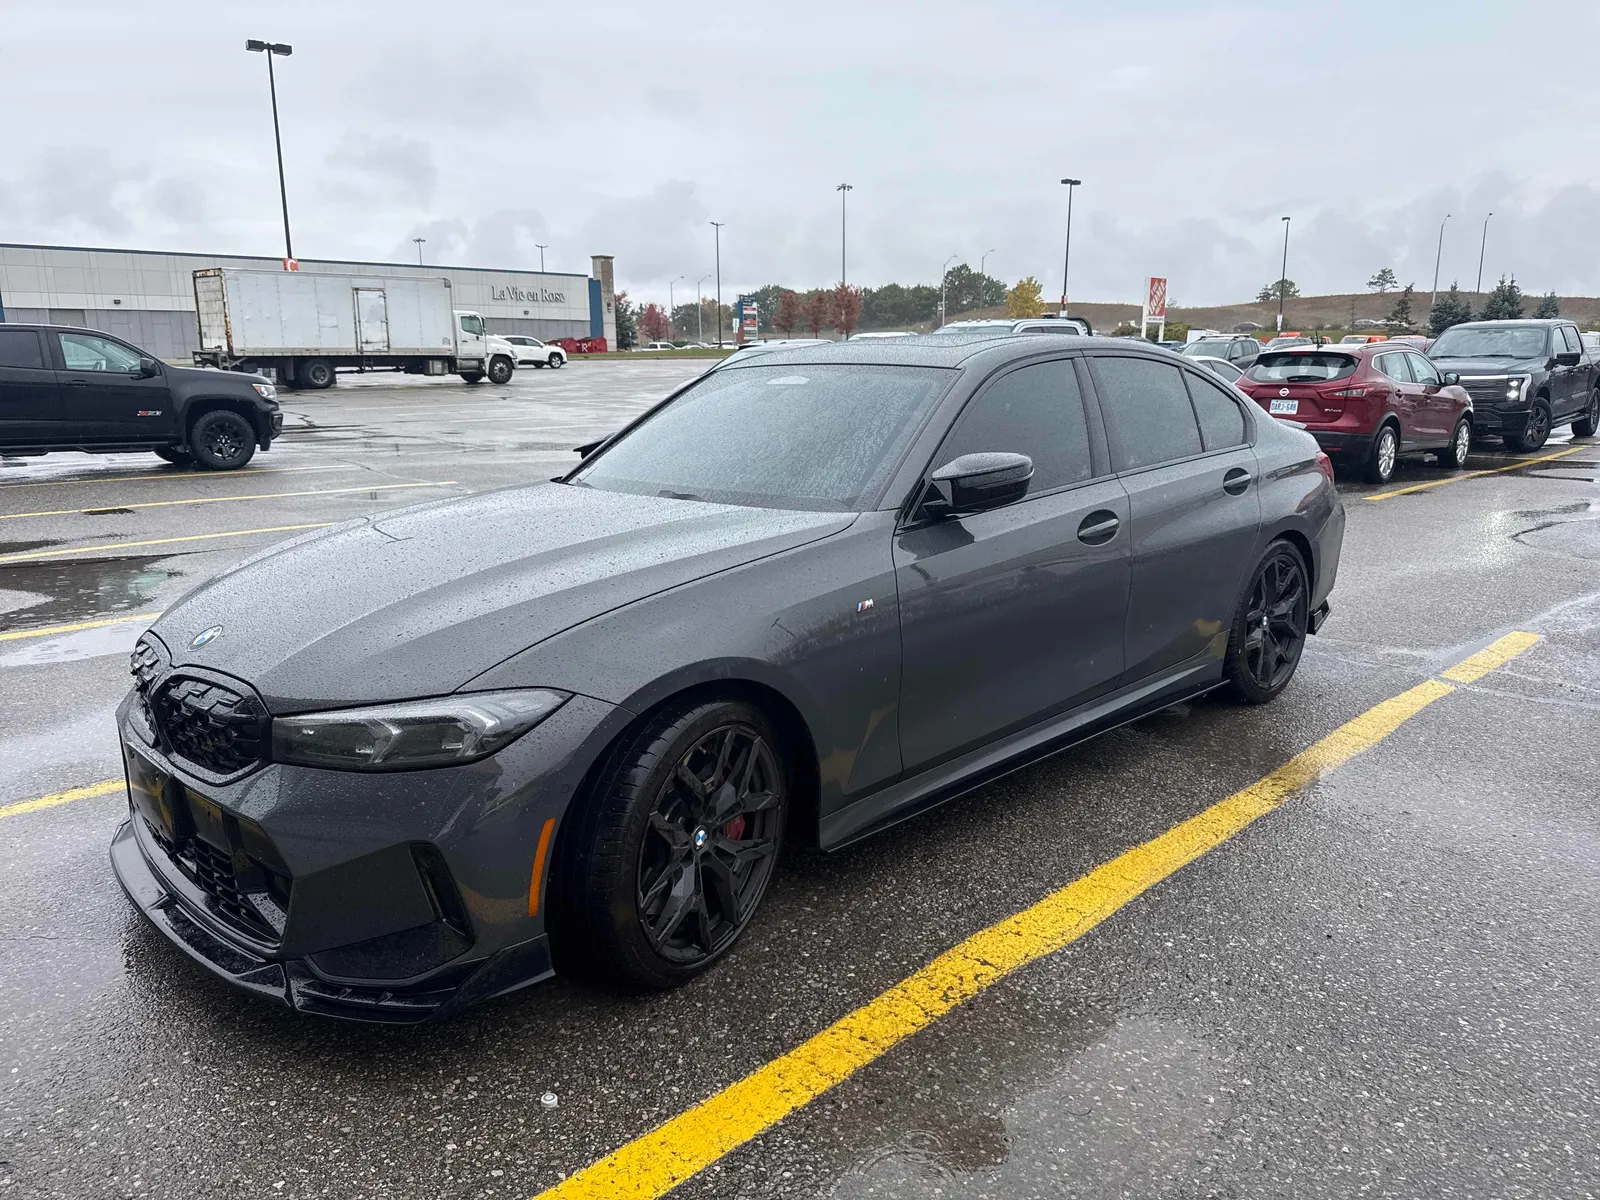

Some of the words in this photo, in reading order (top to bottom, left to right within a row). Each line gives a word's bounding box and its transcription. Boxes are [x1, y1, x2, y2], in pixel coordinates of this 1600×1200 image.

[287, 259, 298, 272] C
[492, 285, 506, 300] La
[506, 286, 525, 301] Vie
[526, 291, 539, 302] en
[540, 288, 565, 303] Rose
